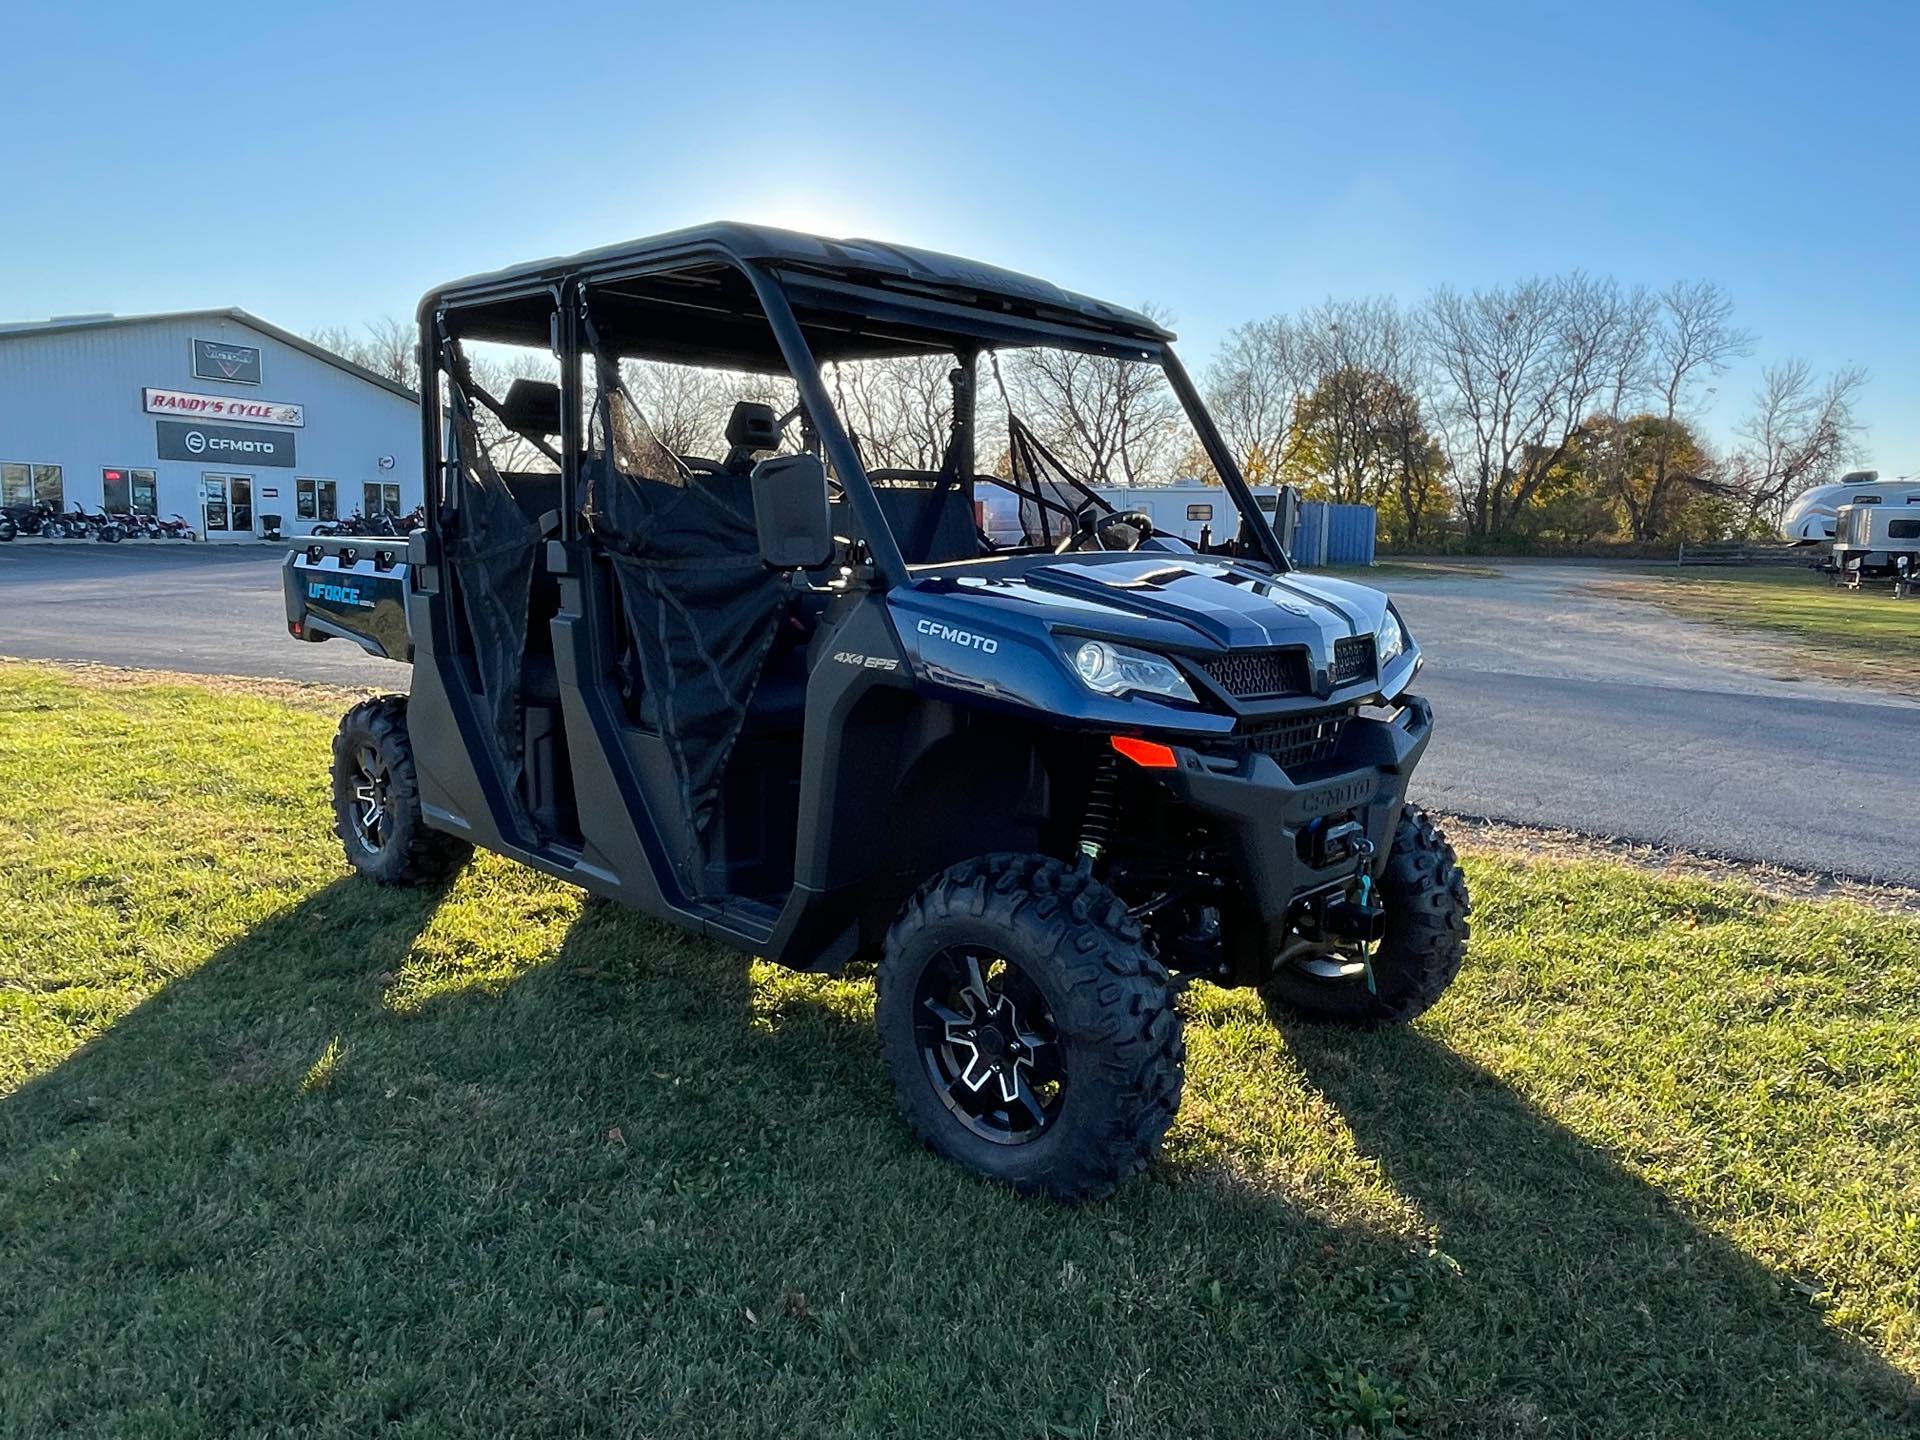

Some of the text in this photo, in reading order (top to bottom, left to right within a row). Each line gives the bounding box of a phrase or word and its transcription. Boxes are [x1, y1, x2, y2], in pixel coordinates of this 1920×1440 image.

[153, 394, 274, 418] RANDY'S CYCLE
[208, 439, 274, 454] CFMOTO
[308, 582, 360, 605] UFORCE
[916, 619, 998, 655] CFMOTO
[833, 652, 900, 671] 4X4 EPS
